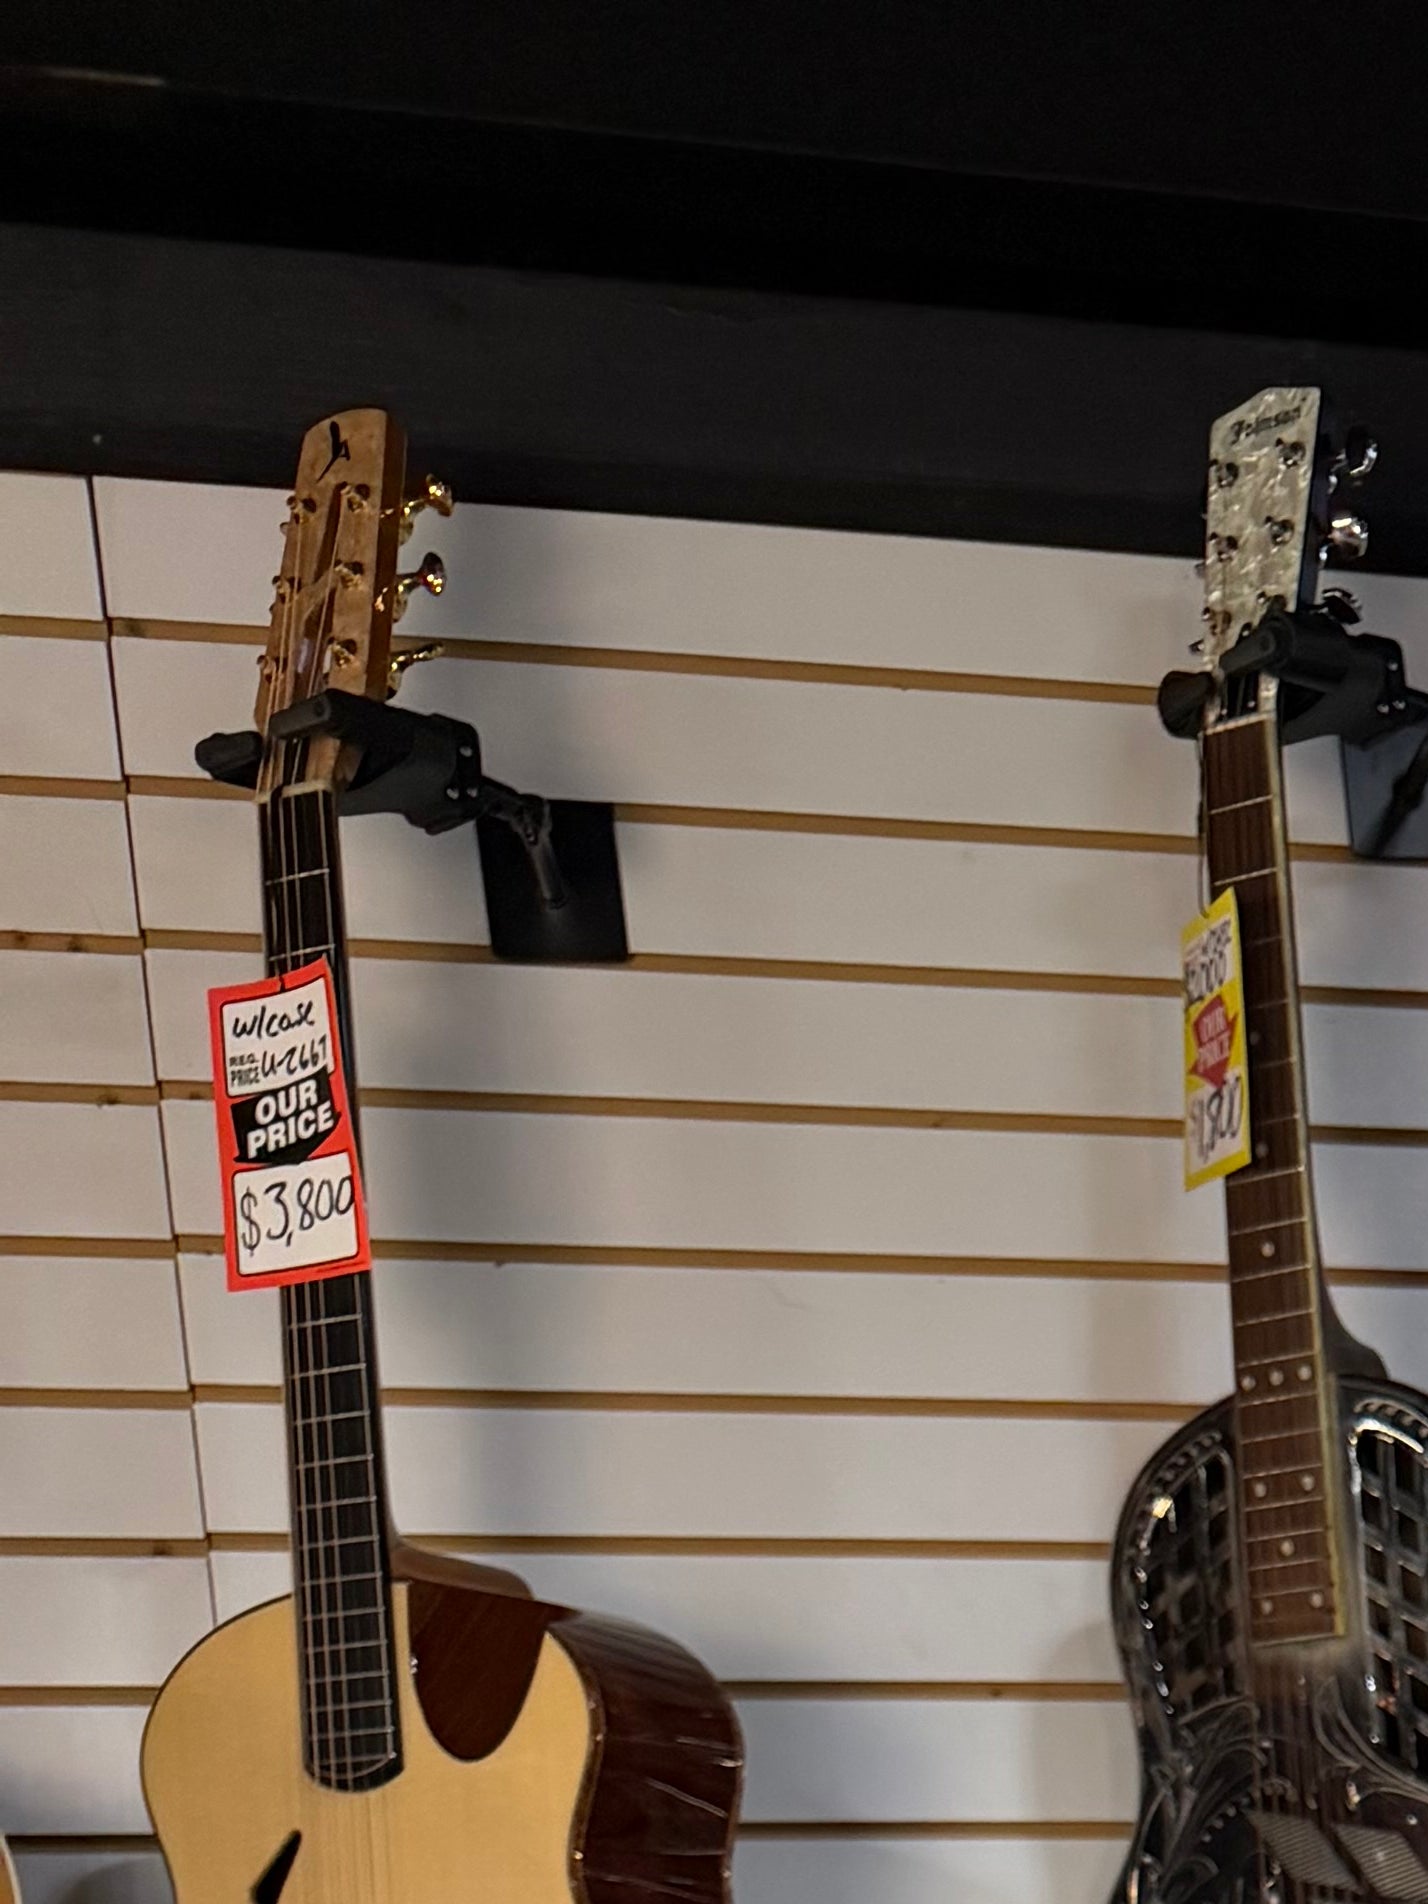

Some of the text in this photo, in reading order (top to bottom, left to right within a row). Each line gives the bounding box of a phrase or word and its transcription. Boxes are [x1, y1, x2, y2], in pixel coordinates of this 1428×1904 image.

[247, 1100, 335, 1160] PRICE
[255, 1078, 318, 1127] OUR
[240, 1174, 354, 1256] $3,800
